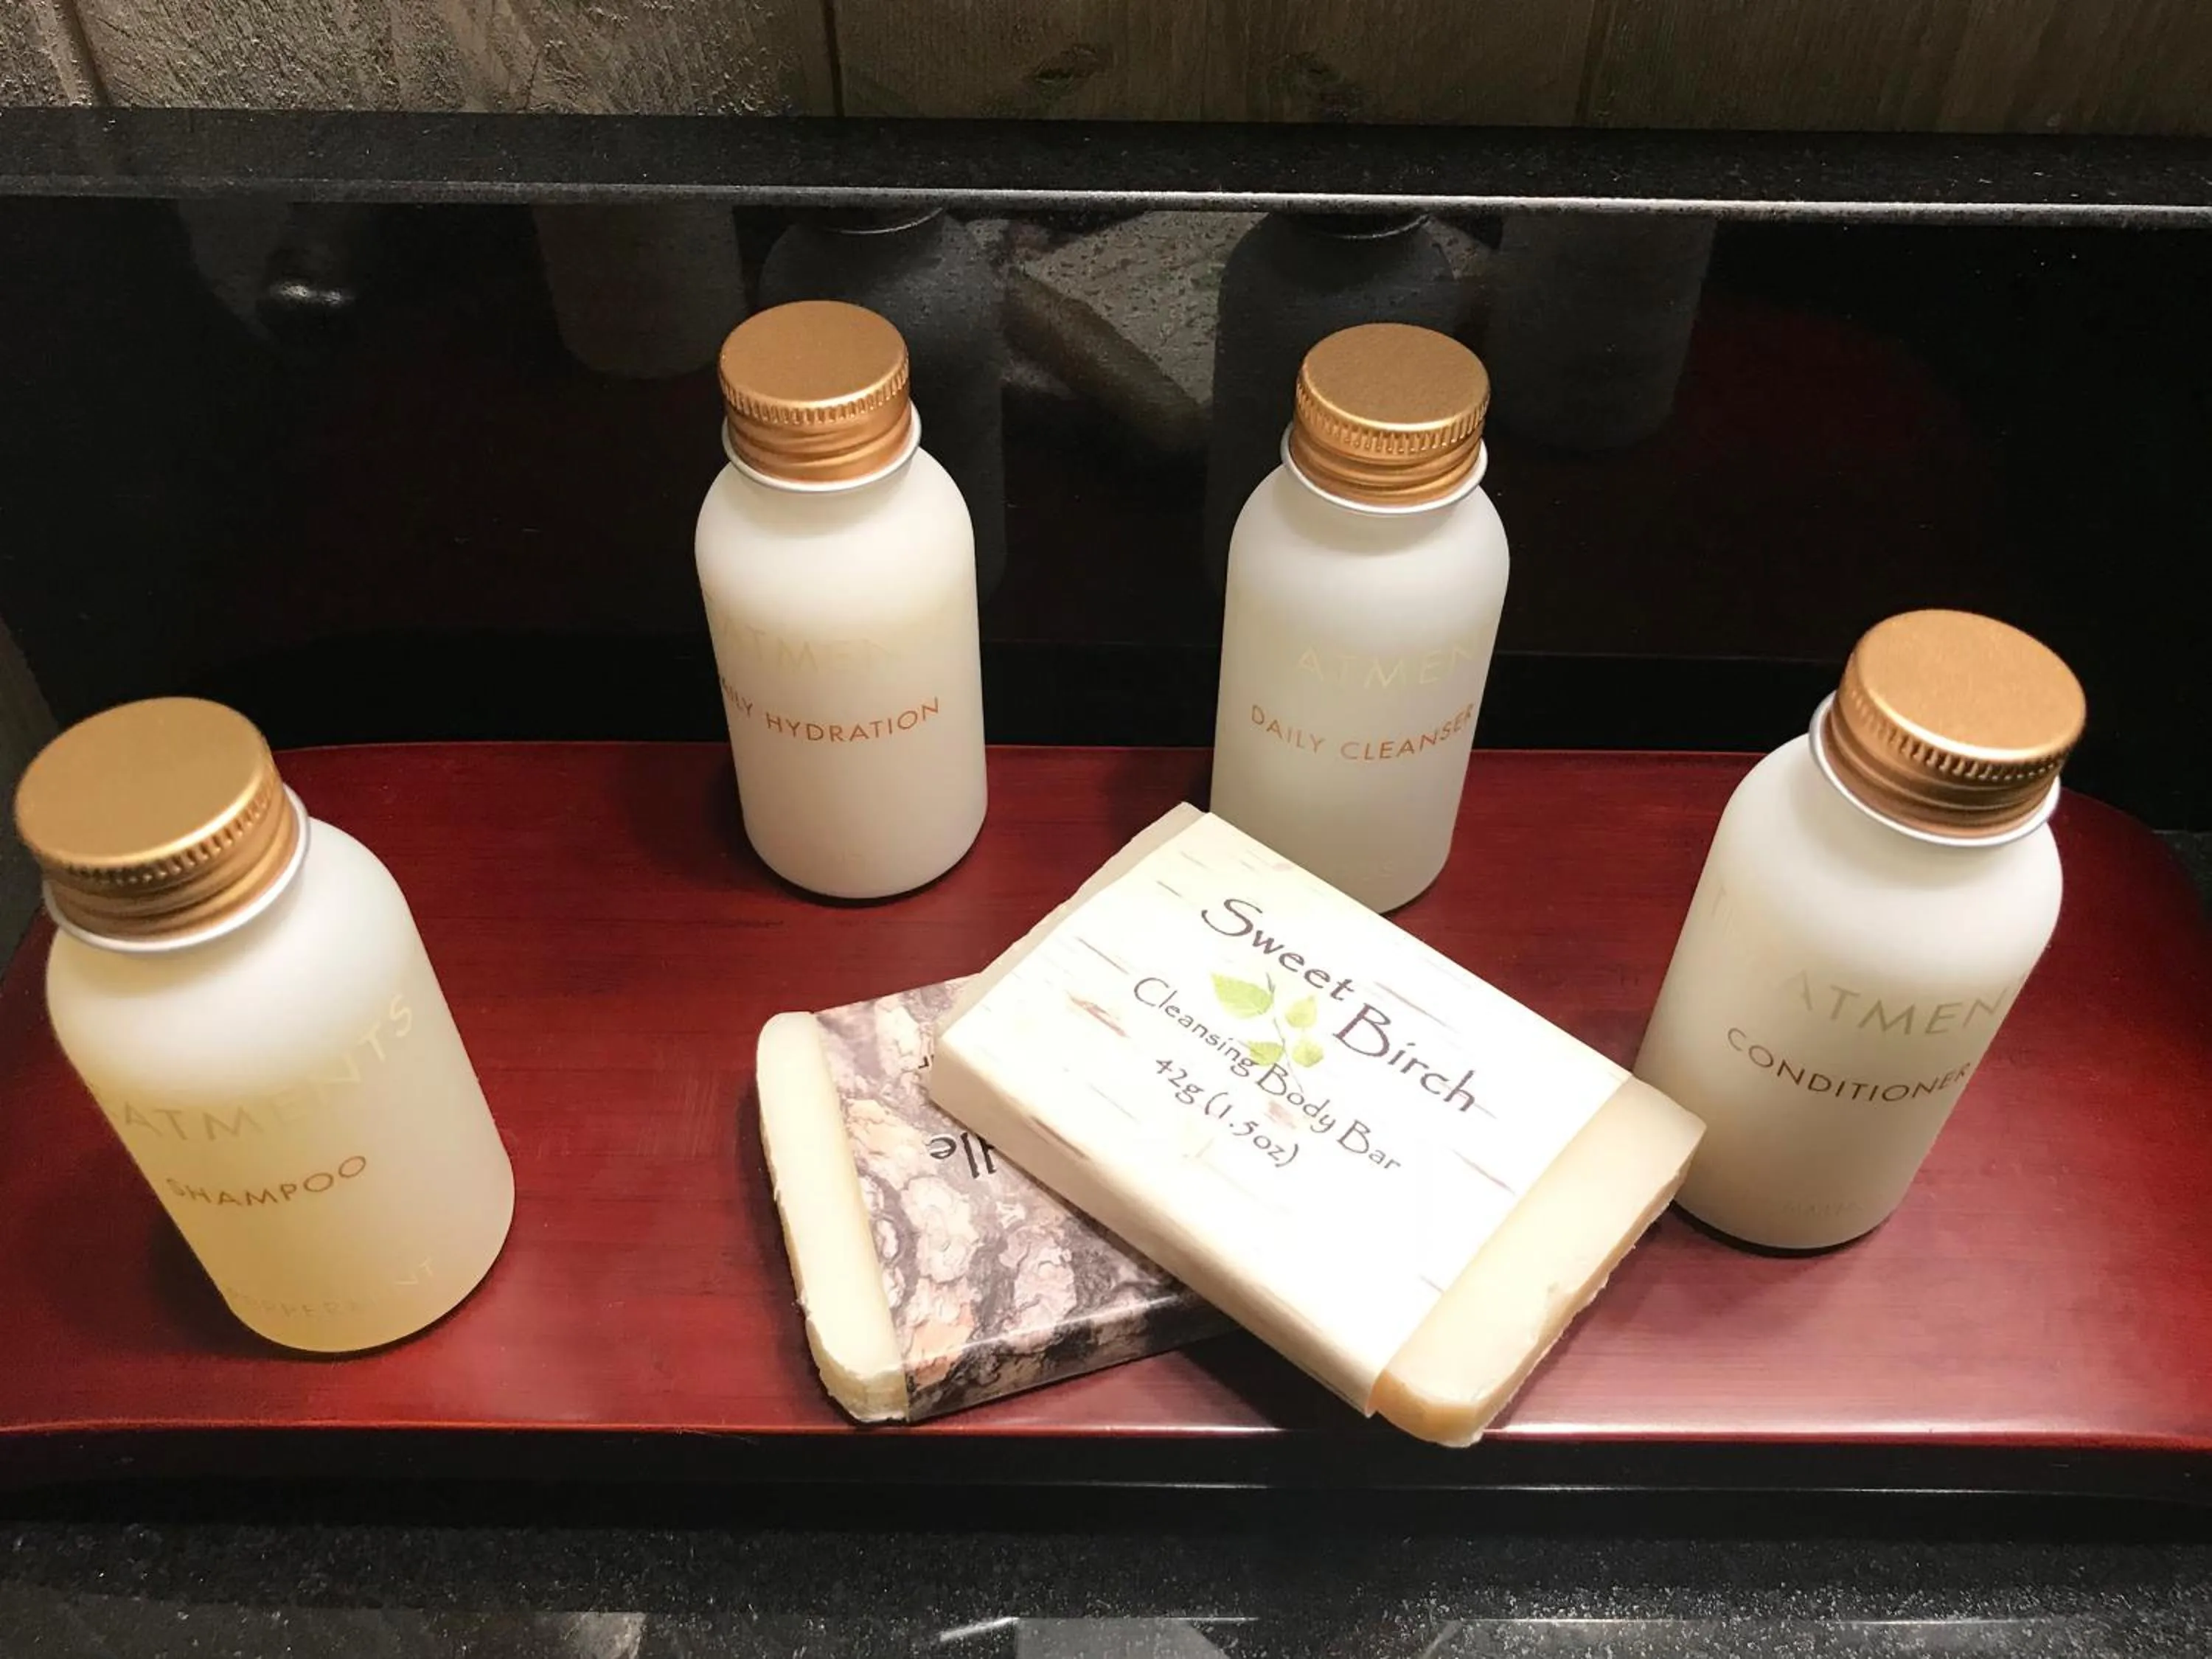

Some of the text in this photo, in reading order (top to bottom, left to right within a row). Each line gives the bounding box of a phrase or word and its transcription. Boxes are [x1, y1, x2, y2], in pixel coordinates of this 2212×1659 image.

[765, 697, 939, 742] HYDRATION
[1251, 702, 1475, 761] DAILY CLEANSER
[1200, 897, 1476, 1114] Sweet Birch
[1133, 976, 1401, 1172] Cleansing Body Bar
[1727, 1026, 1971, 1102] CONDITIONER
[1155, 1057, 1300, 1169] 42g (1.5oz)
[166, 1155, 366, 1206] SHAMPOO
